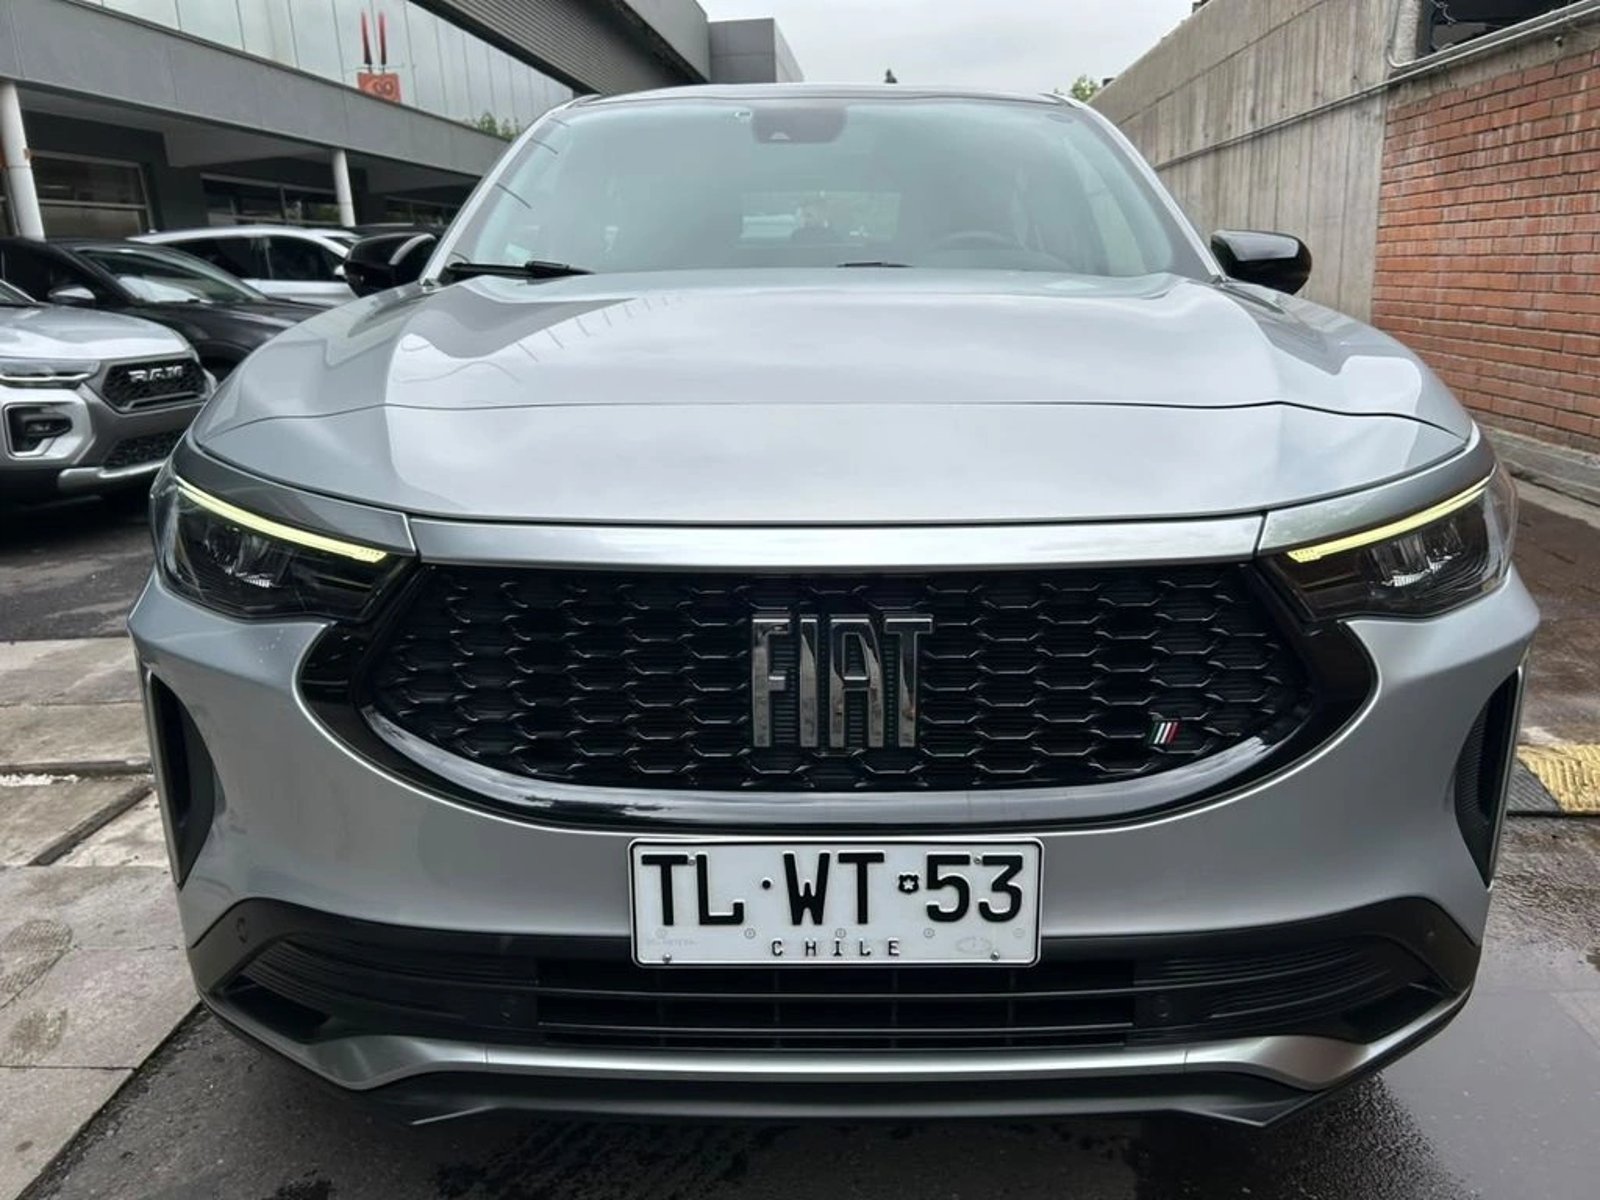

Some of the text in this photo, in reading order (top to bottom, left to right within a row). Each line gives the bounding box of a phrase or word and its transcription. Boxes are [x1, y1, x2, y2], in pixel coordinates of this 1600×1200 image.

[127, 365, 183, 383] RAM
[752, 613, 934, 748] FIAT
[771, 940, 899, 957] CHILE
